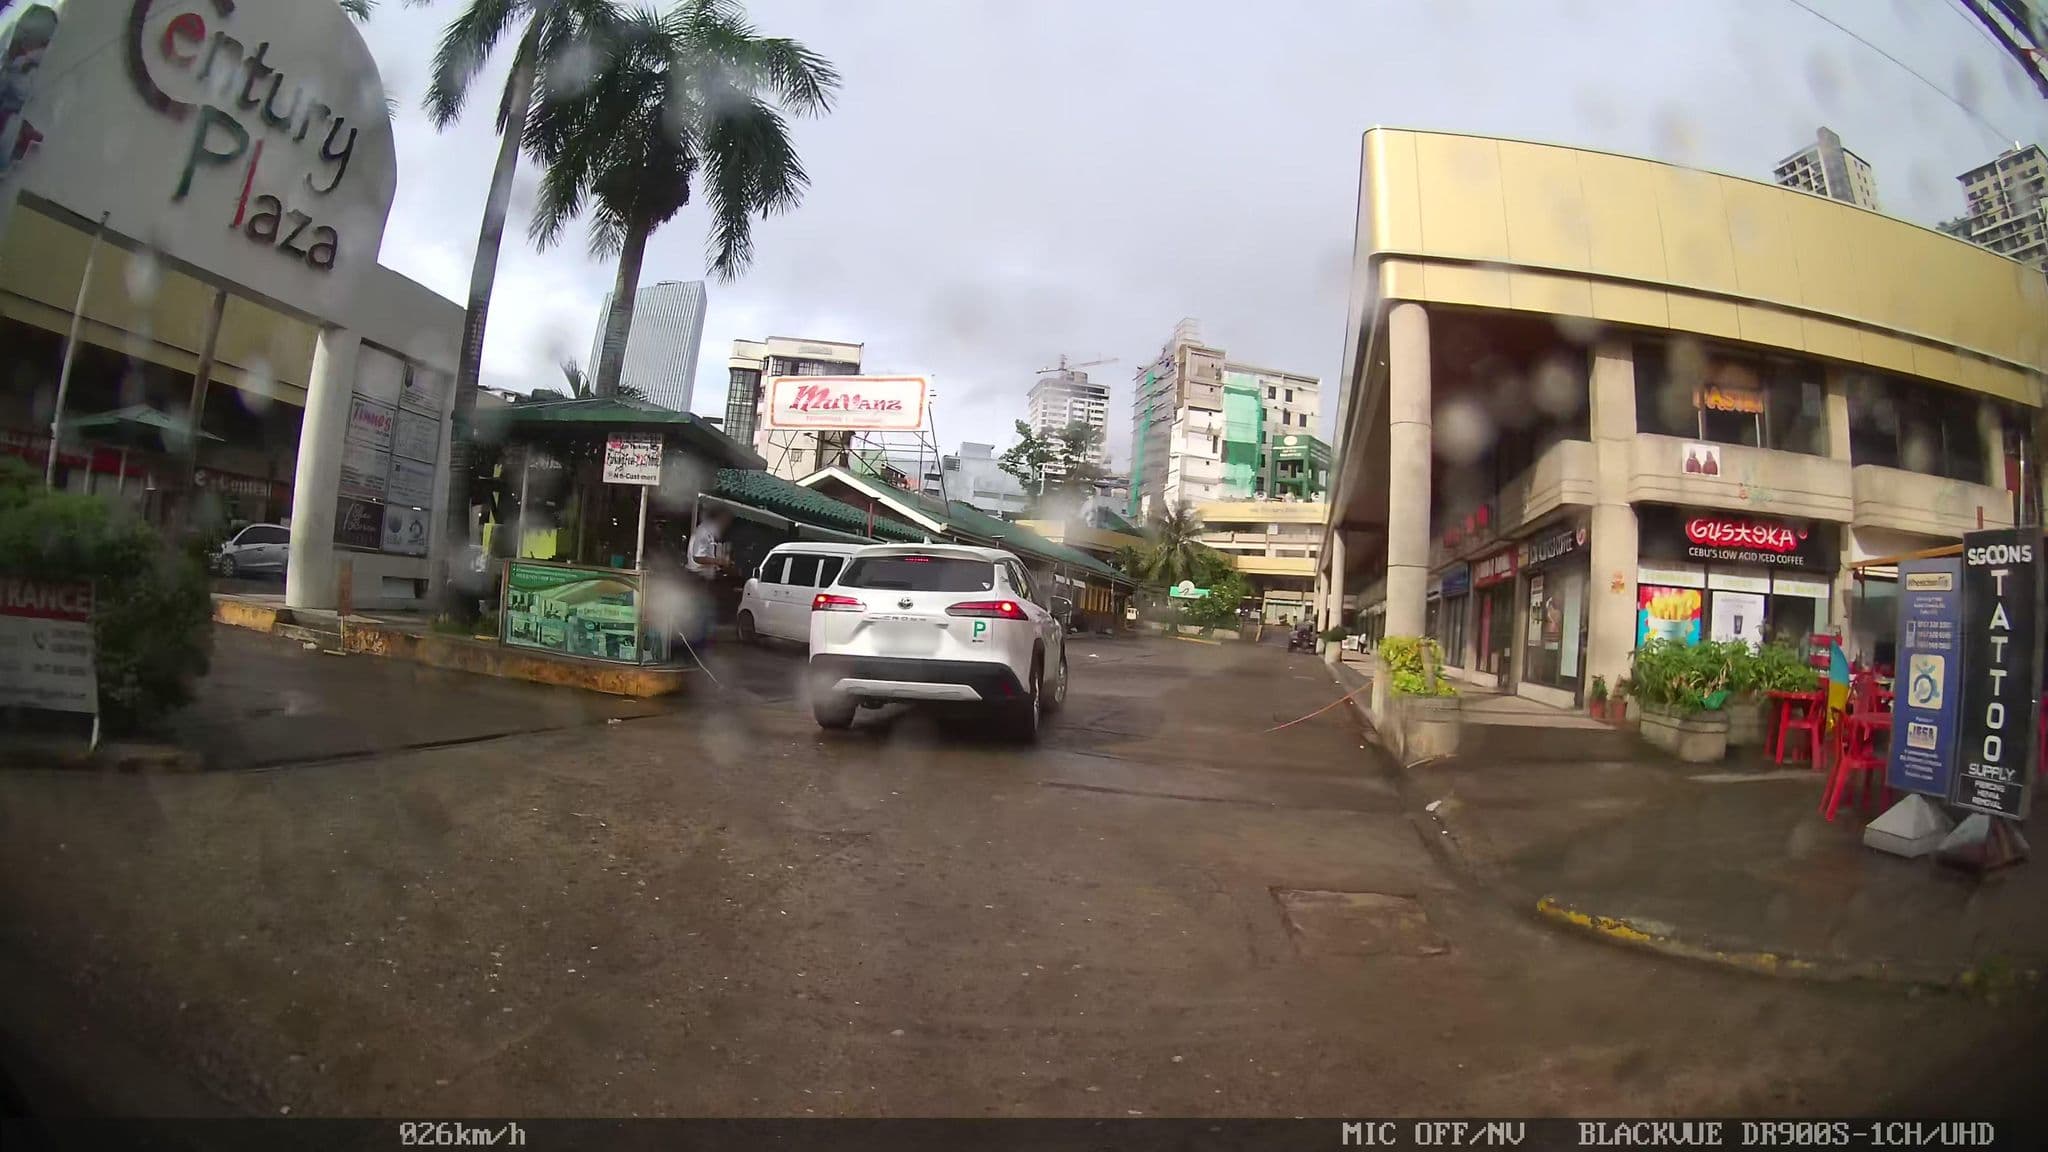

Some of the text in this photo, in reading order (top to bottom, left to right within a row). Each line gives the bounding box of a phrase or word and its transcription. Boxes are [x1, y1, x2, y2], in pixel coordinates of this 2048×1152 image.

[125, 0, 358, 194] Century
[172, 104, 339, 271] Plaza
[1688, 547, 1718, 559] CEBU'S
[1719, 550, 1737, 560] LOW
[1738, 551, 1758, 562] ACID
[1776, 554, 1804, 566] COFFEE
[973, 620, 987, 638] P
[1983, 569, 2011, 763] TATTOO
[1968, 762, 2016, 781] SUPPLY
